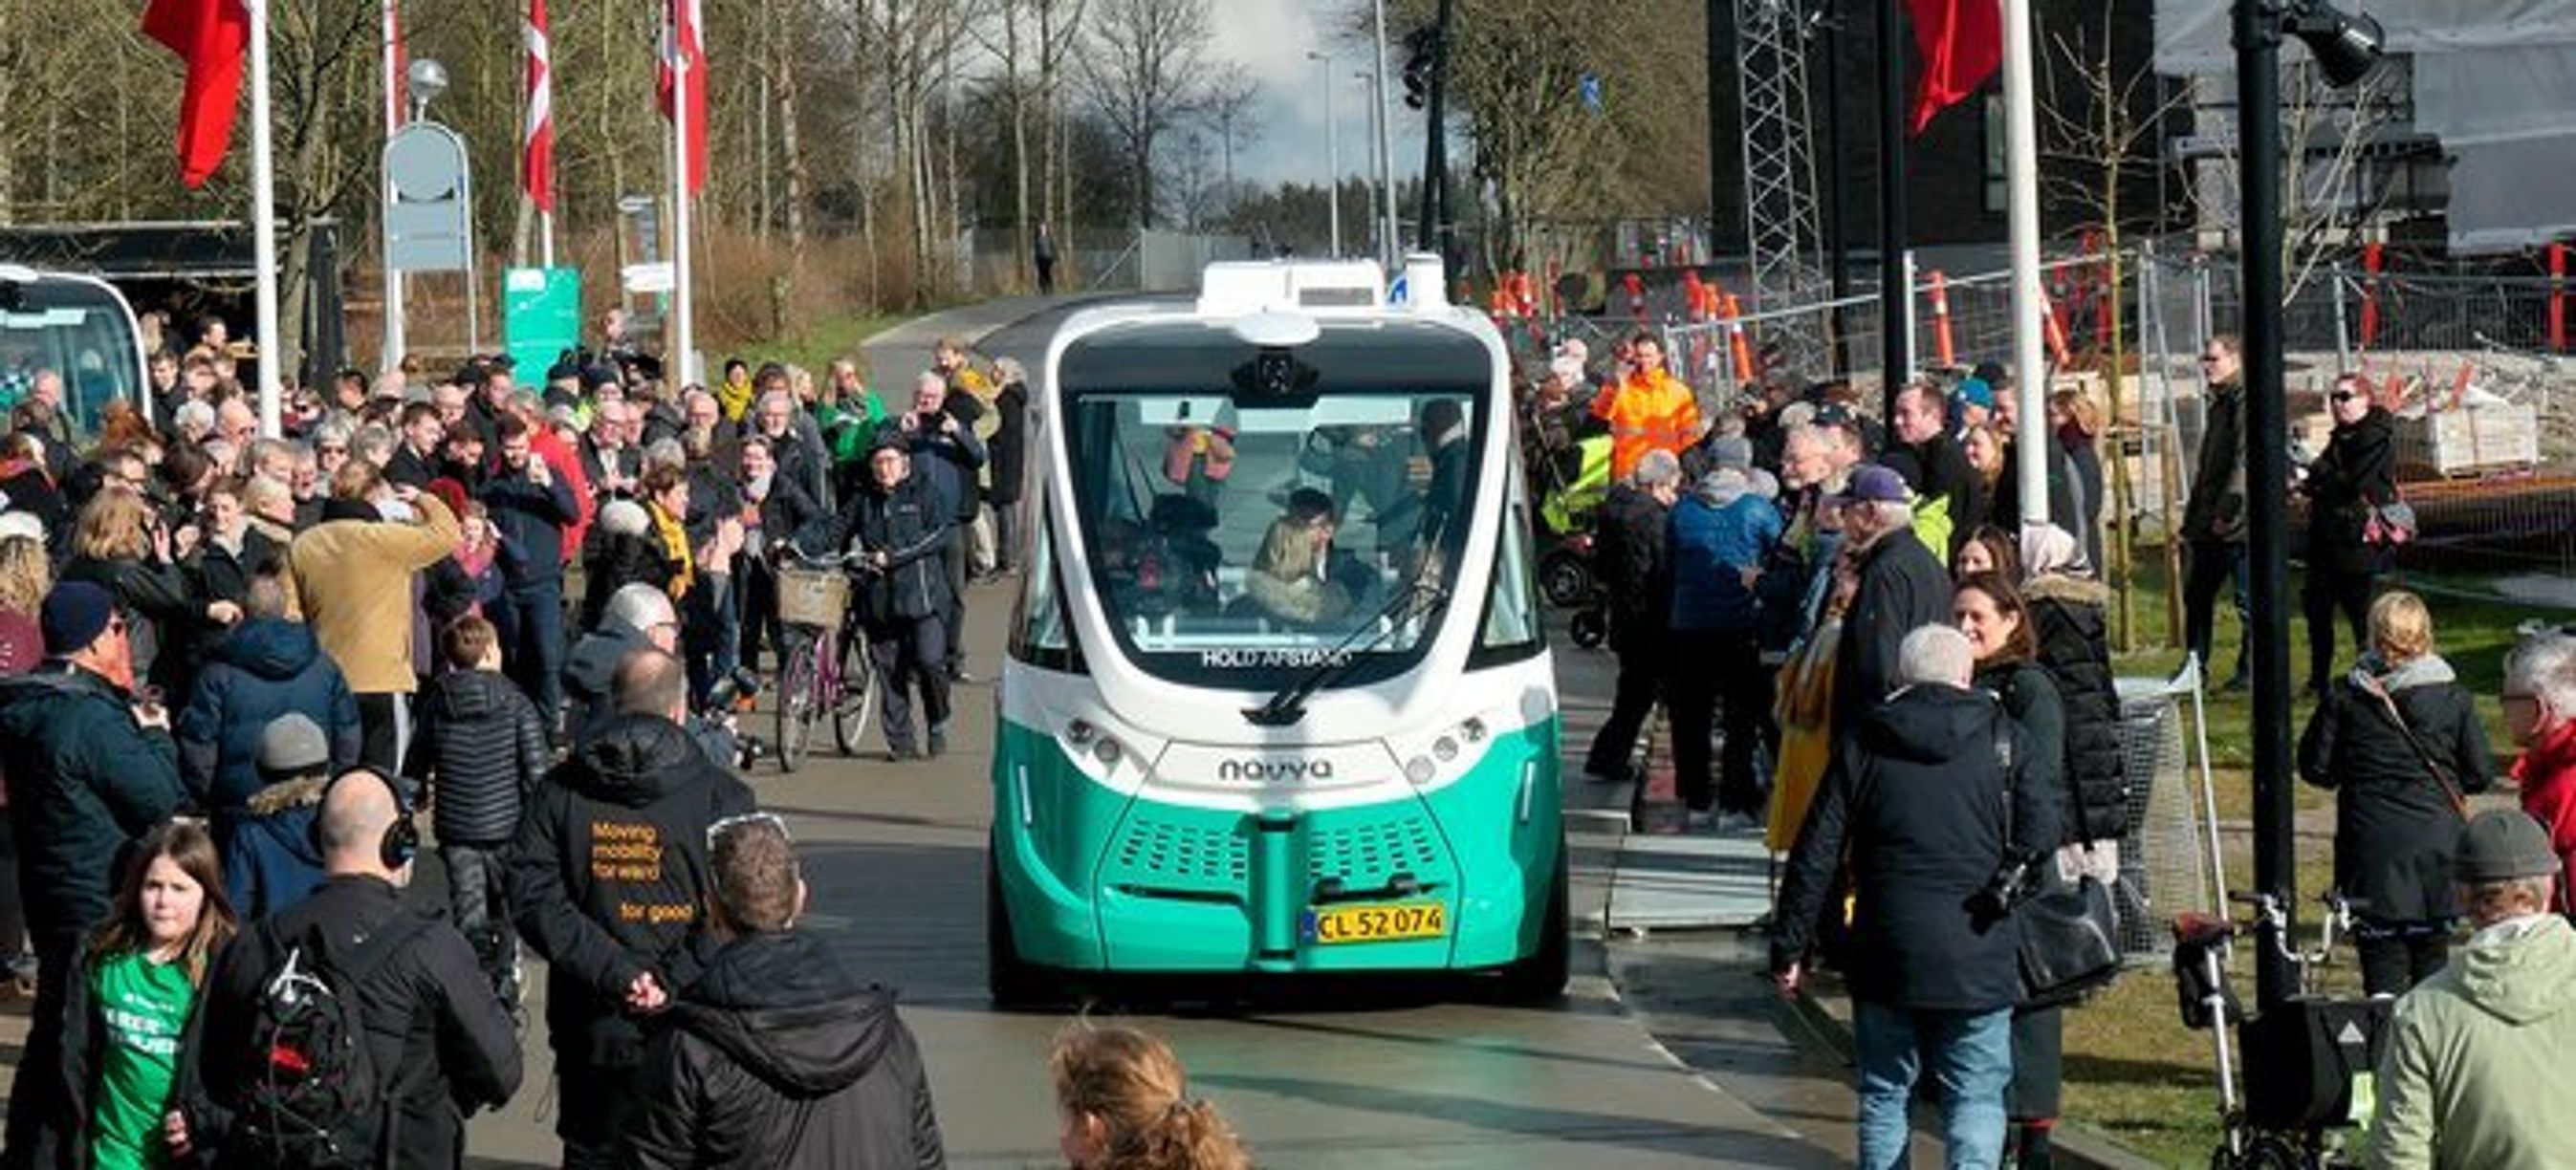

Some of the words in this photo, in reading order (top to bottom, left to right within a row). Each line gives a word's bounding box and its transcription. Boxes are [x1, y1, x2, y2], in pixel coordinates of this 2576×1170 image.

[1203, 648, 1256, 667] HOLD
[592, 822, 657, 843] Moving
[592, 843, 664, 862] mobility
[592, 860, 661, 880] forward
[621, 901, 644, 919] for
[648, 903, 692, 924] good
[1319, 915, 1351, 940] CL
[1358, 911, 1388, 936] 52
[1394, 908, 1442, 933] 074
